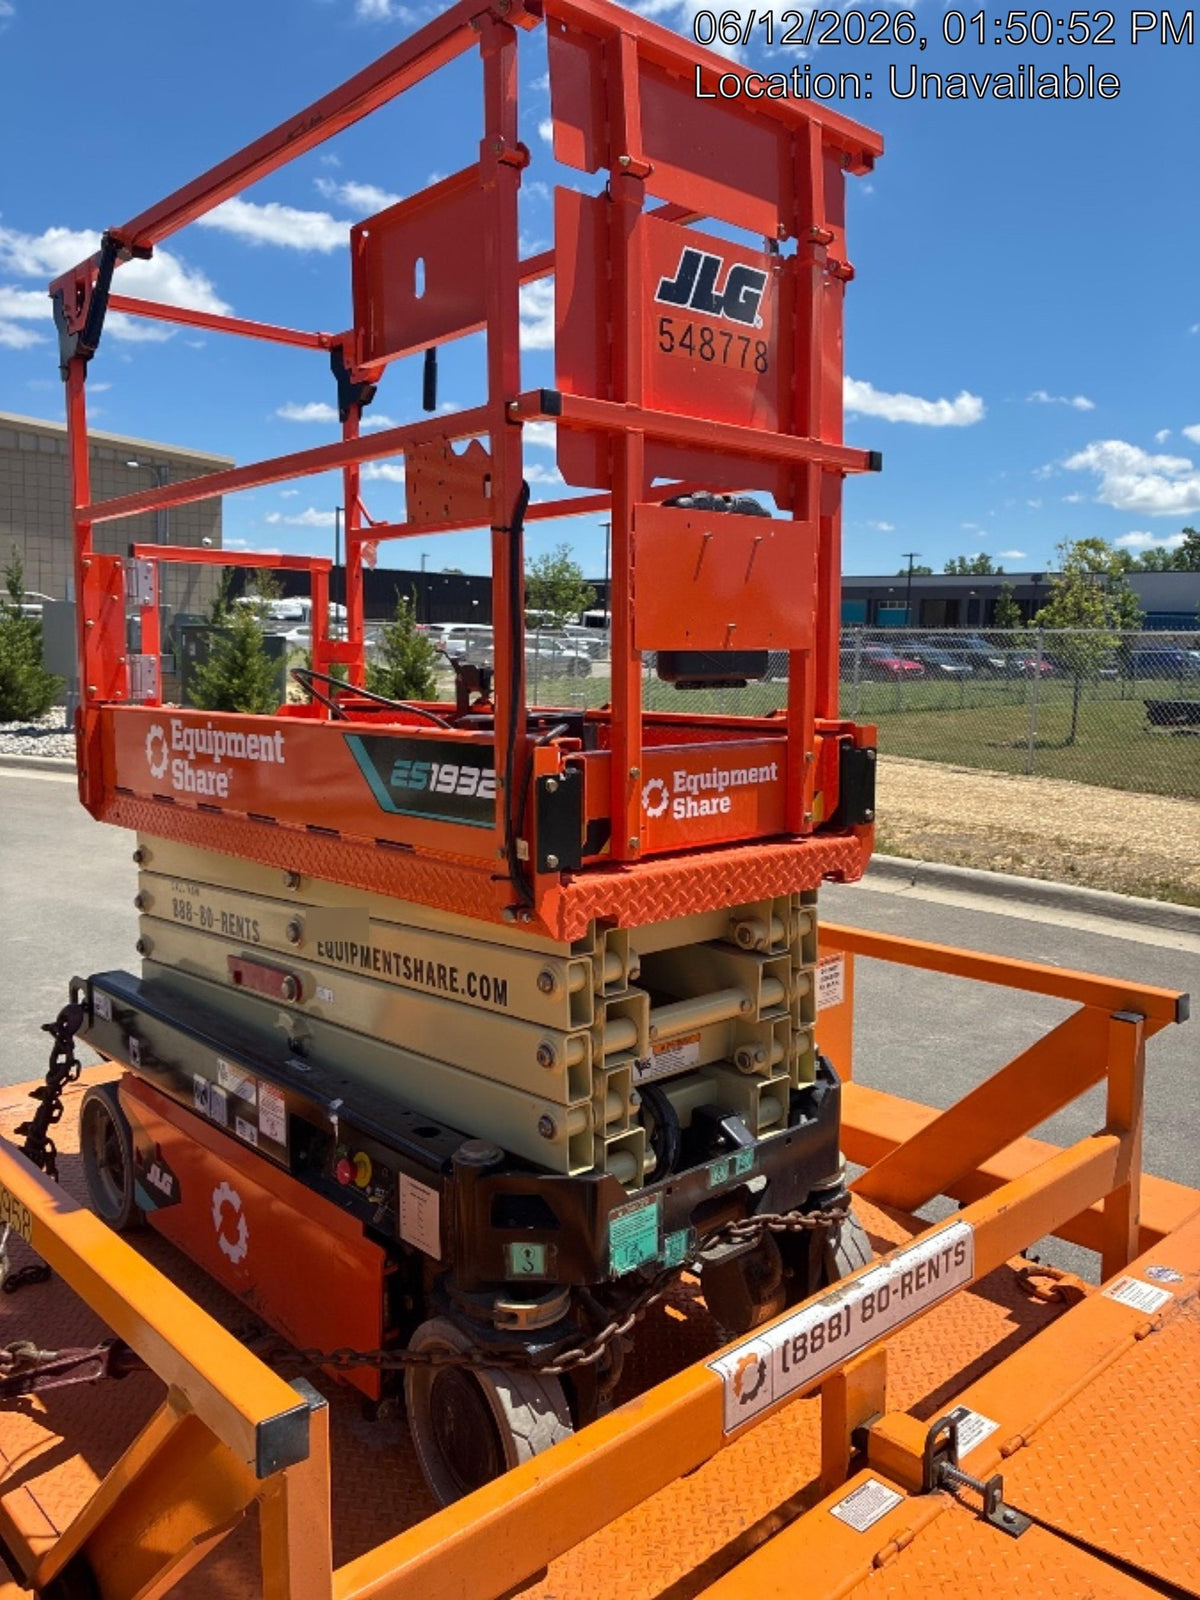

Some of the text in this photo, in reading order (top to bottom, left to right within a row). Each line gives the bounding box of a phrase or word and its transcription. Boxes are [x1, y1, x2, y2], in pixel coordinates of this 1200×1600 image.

[654, 245, 769, 328] JLG
[658, 317, 769, 374] 548778
[170, 718, 285, 764] Equipment
[171, 758, 229, 799] Share
[390, 758, 497, 799] ES1932
[673, 761, 779, 796] Equipment
[673, 795, 732, 820] Share
[171, 896, 261, 943] 888-80-RENTS
[316, 941, 509, 1007] EQUIPMENTSHARE.COM
[146, 1162, 173, 1198] JLG
[0, 1184, 31, 1242] 958
[781, 1240, 966, 1373] (888) 80-RENTS
